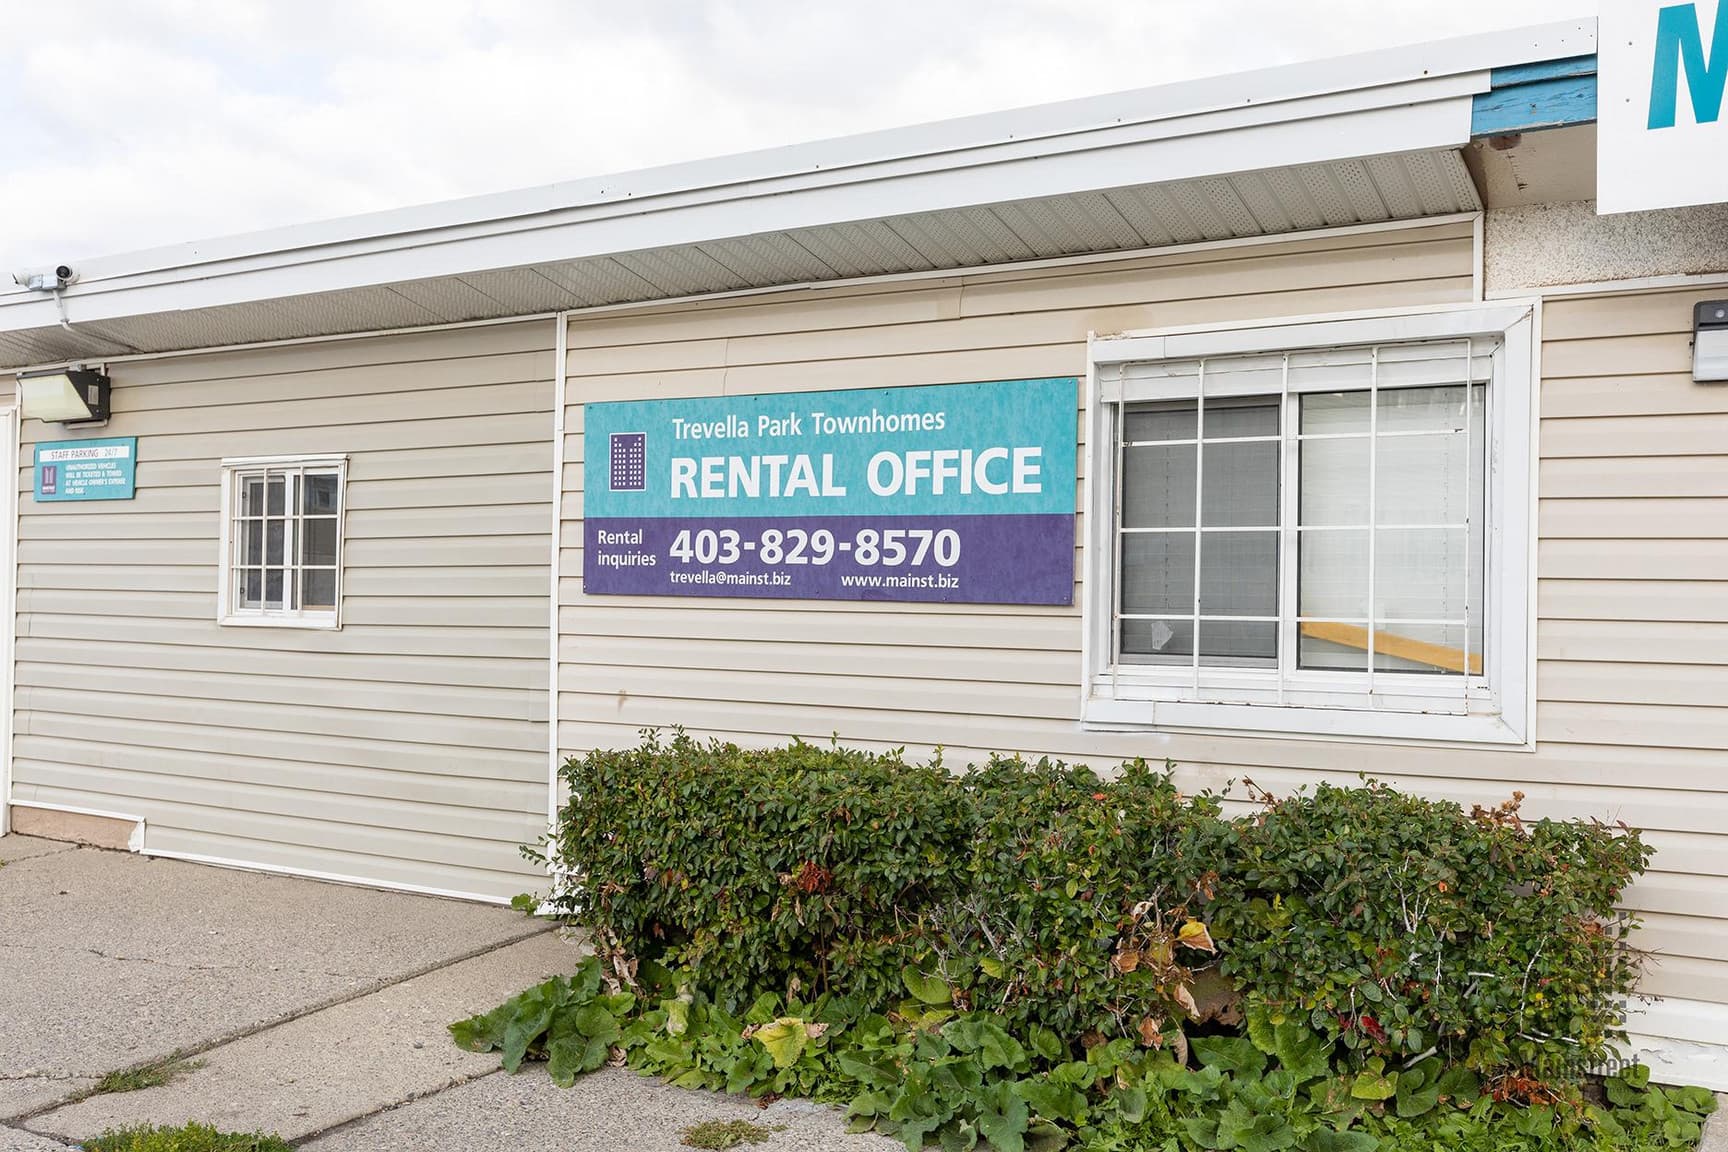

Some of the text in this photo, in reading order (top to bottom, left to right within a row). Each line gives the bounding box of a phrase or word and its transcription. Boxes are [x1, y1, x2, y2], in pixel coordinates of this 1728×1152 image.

[672, 408, 946, 440] Trevella Park Townhomes
[51, 451, 69, 460] STAFF
[71, 448, 98, 459] PARKING
[670, 446, 1042, 499] RENTAL OFFICE
[597, 529, 643, 545] Rental
[669, 528, 961, 567] 403-829-8570
[597, 550, 656, 569] inquiries
[669, 570, 792, 586] trevella@mainst.biz
[841, 572, 960, 589] www.mainst.biz
